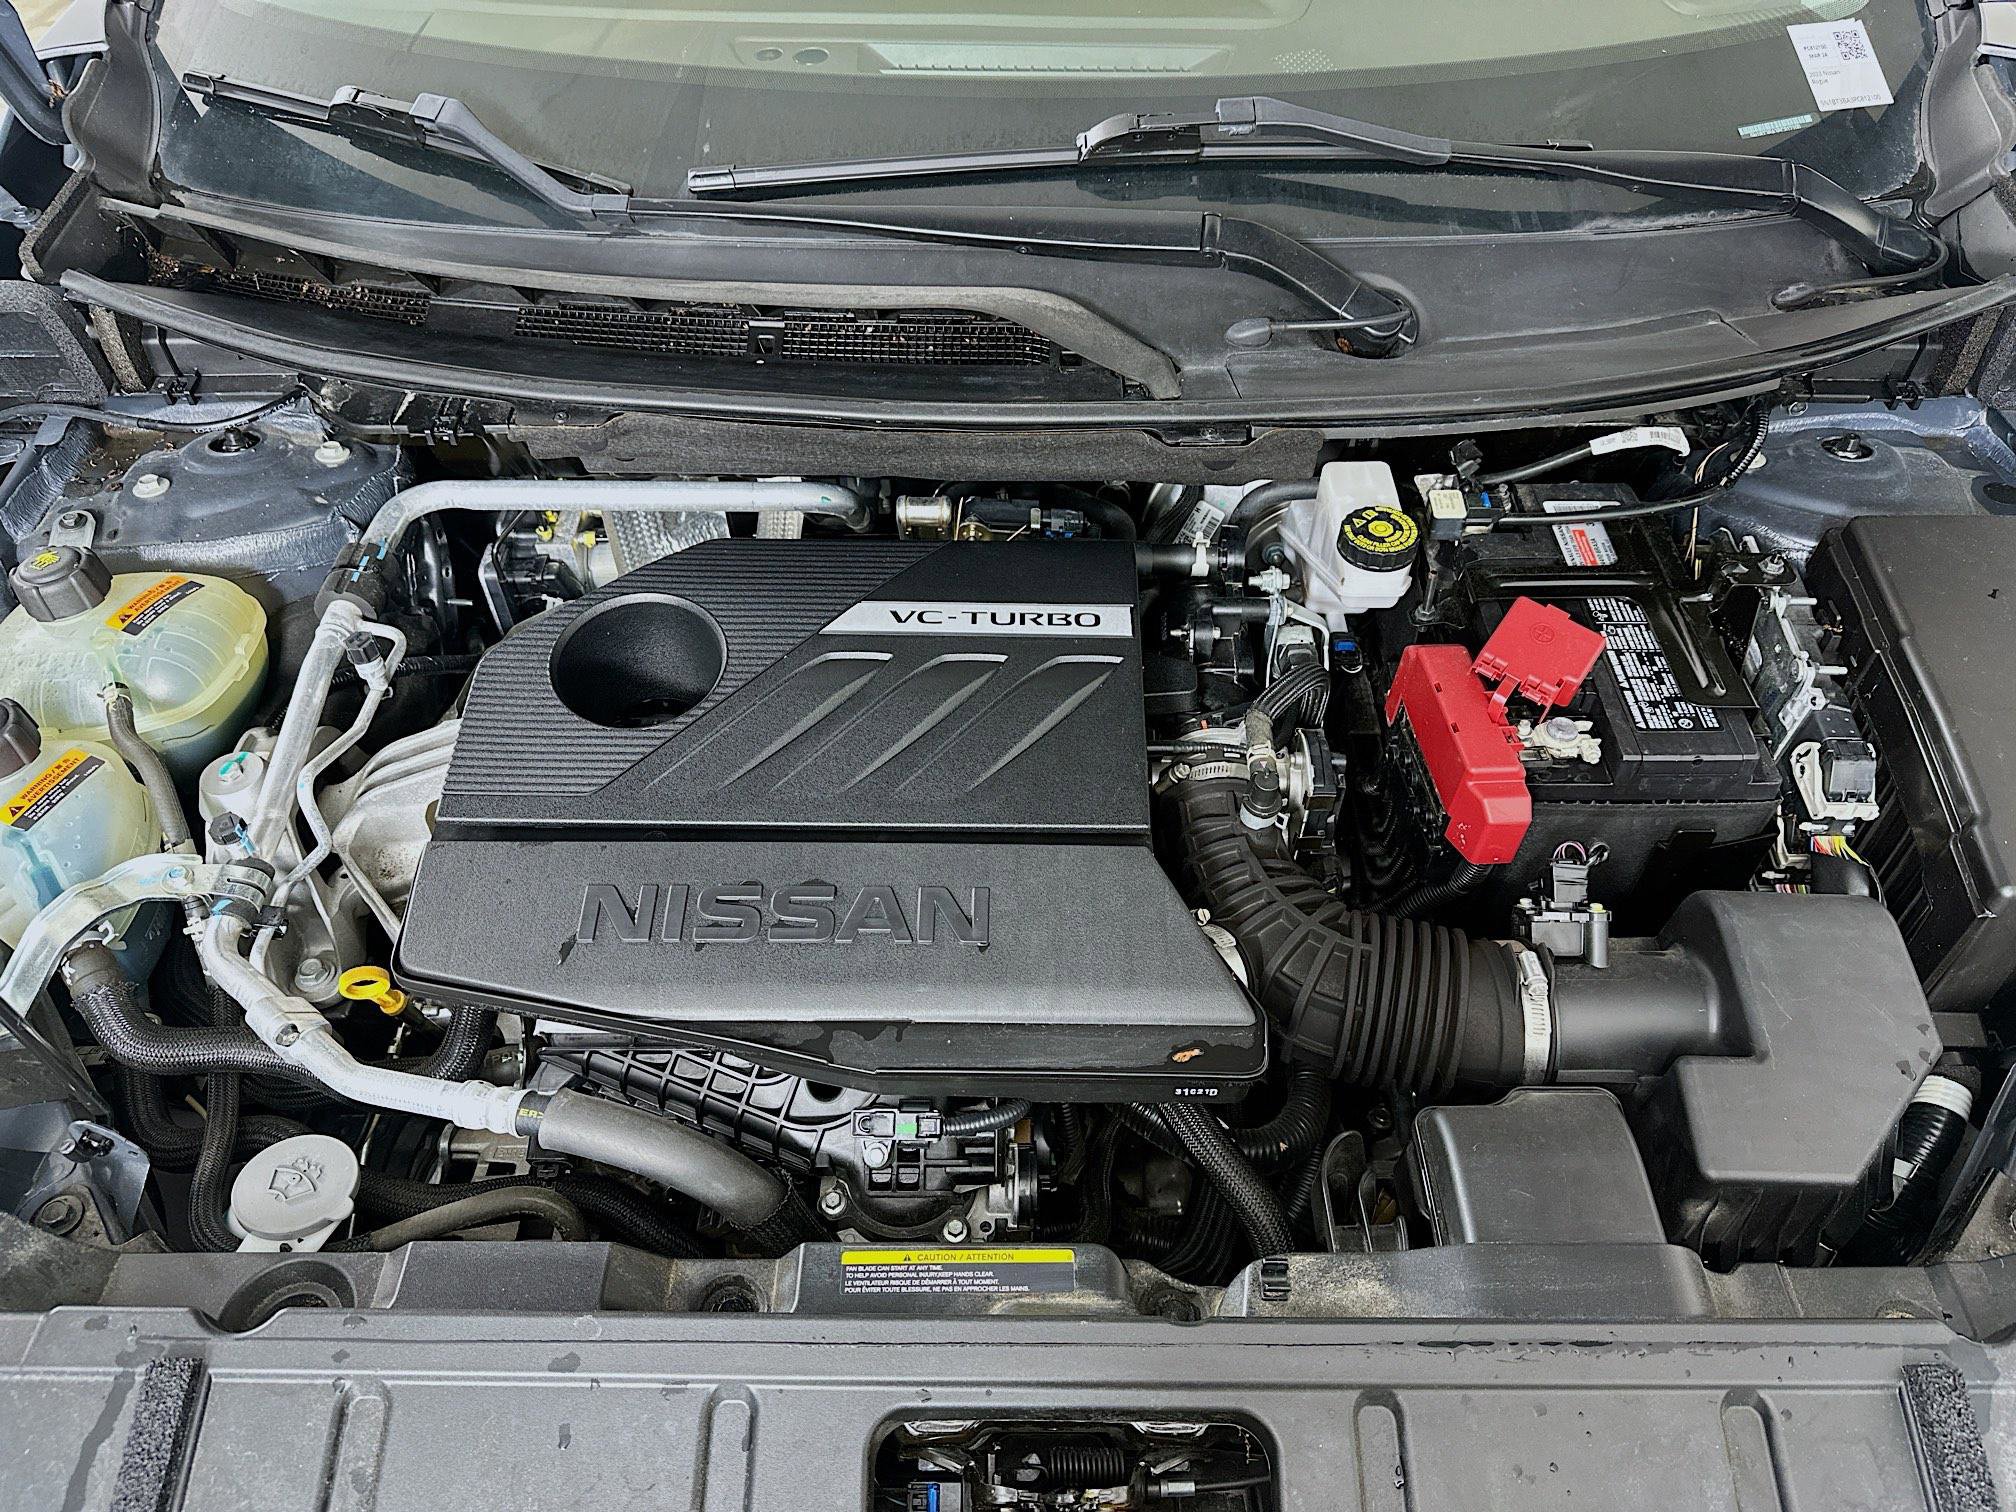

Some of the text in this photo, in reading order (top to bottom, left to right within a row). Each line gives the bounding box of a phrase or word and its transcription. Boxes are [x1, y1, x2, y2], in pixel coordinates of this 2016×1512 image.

[889, 610, 1101, 627] VC-TURBO
[20, 771, 53, 799] WARNING
[27, 758, 80, 803] AVERTISSEMENT
[577, 883, 992, 945] NISSAN
[916, 1253, 957, 1262] CAUTION
[966, 1252, 1015, 1261] ATTENTION
[862, 1285, 881, 1293] ÉVITER
[920, 1278, 952, 1286] DÉMARRER
